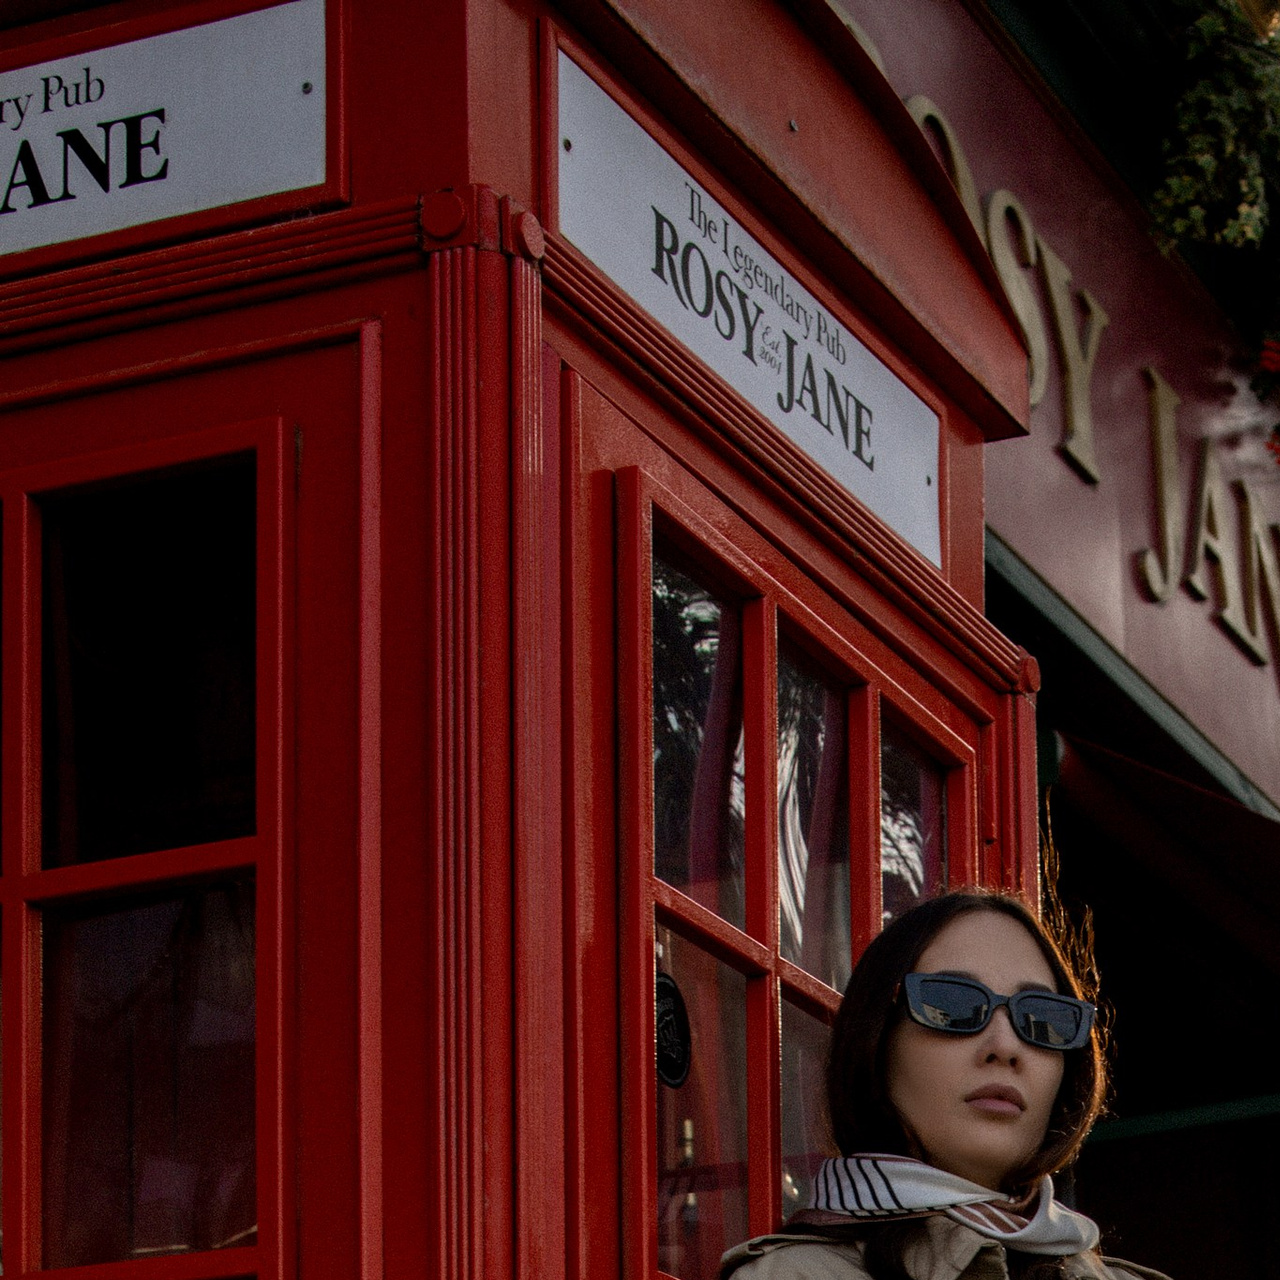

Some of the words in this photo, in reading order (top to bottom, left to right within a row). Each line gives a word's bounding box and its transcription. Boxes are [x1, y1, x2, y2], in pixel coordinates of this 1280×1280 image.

[0, 108, 169, 214] ANE
[41, 67, 105, 113] Pub
[651, 205, 764, 367] ROSY
[777, 329, 875, 472] JANE
[685, 182, 718, 244] The
[722, 218, 813, 340] Legendary
[817, 310, 846, 365] Pub
